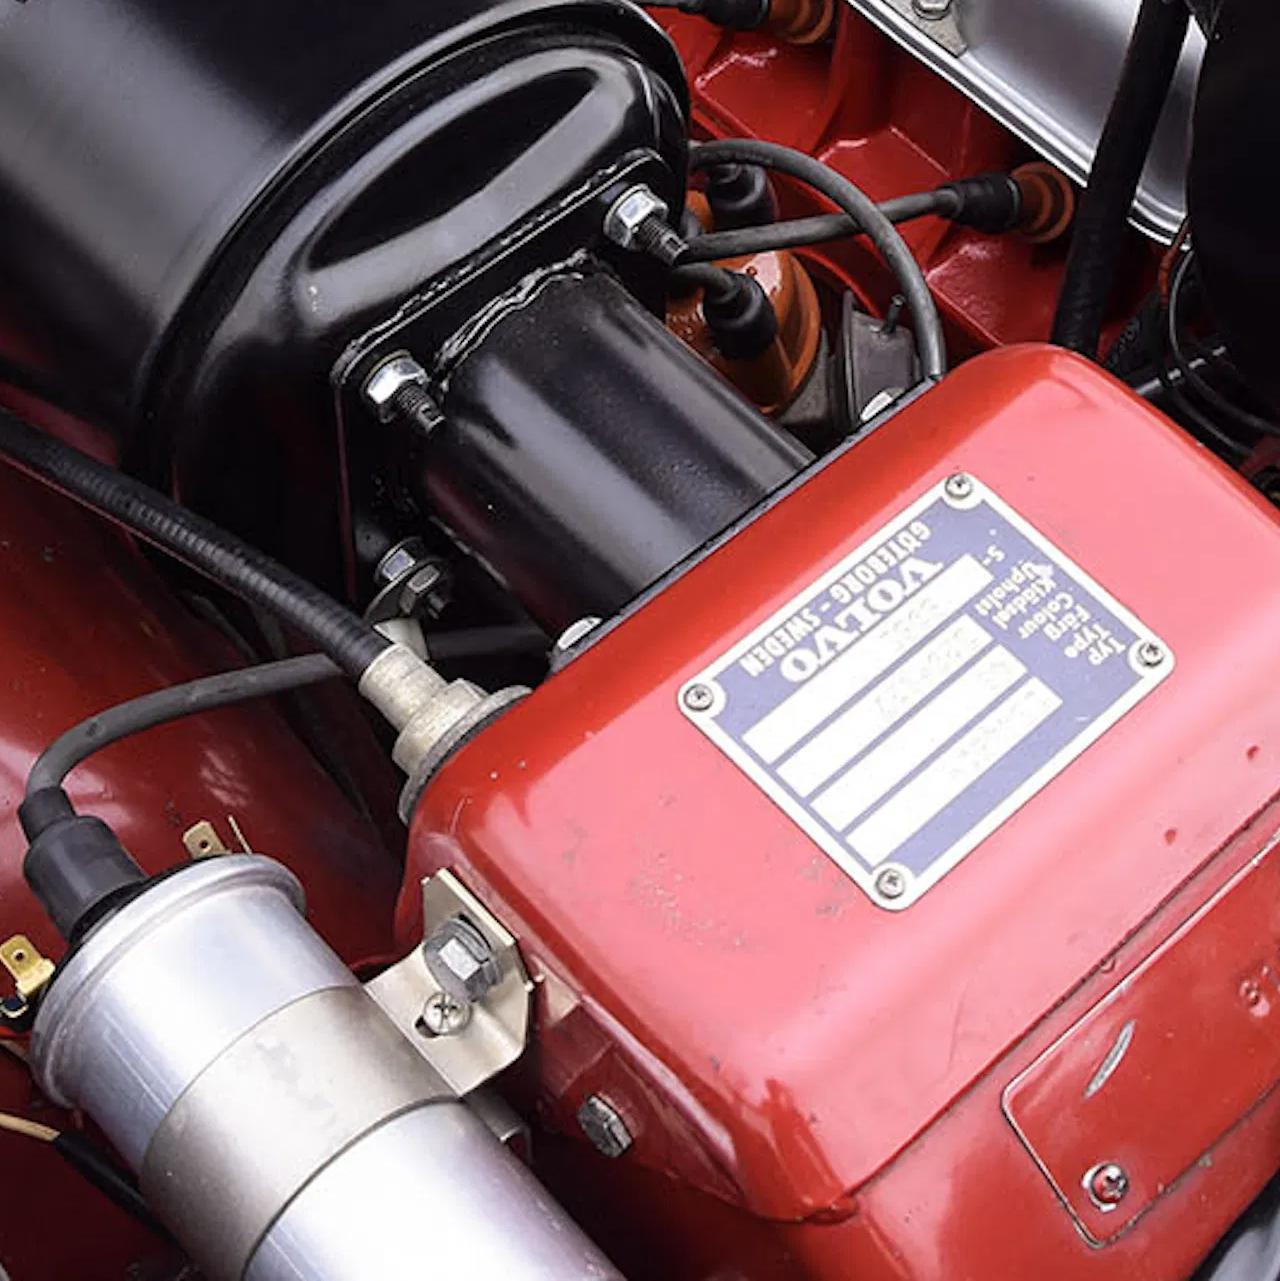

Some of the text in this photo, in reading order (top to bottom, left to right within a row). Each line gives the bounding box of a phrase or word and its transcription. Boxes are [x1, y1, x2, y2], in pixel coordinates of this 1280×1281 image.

[826, 517, 934, 608] GÖTEBORG
[737, 606, 820, 678] SWEDEN
[776, 554, 936, 685] VOLVO
[1014, 590, 1076, 643] Colour
[1041, 602, 1091, 646] Färg
[1061, 616, 1109, 663] Type
[1084, 630, 1126, 670] Typ
